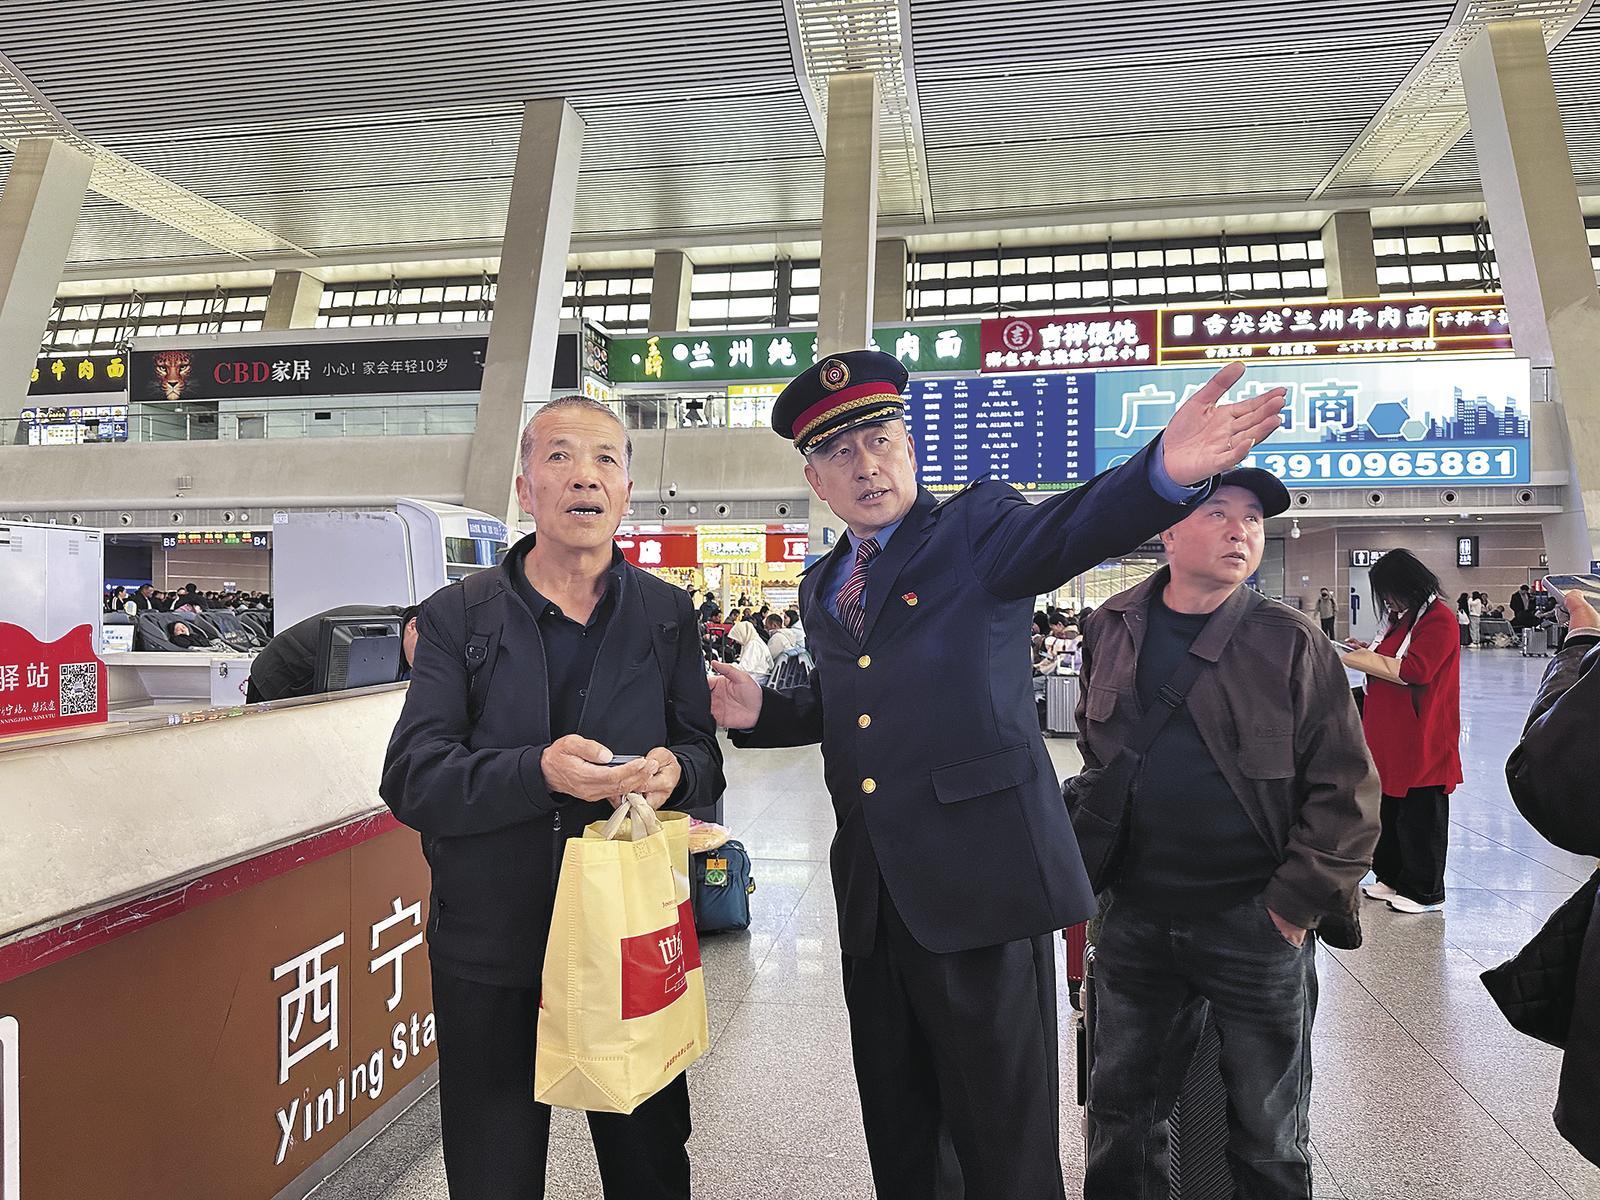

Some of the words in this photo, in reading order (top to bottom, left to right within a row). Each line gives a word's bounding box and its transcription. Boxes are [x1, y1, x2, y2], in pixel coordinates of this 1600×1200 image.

[689, 329, 963, 368] 兰州纯肉面
[213, 359, 311, 384] CBD家居
[1114, 380, 1358, 438] 广商
[163, 537, 176, 547] B5
[253, 536, 266, 546] B4
[0, 662, 49, 691] 驿站
[273, 896, 424, 1085] 西宁
[275, 1048, 385, 1166] Xining
[391, 1011, 436, 1071] Sta
